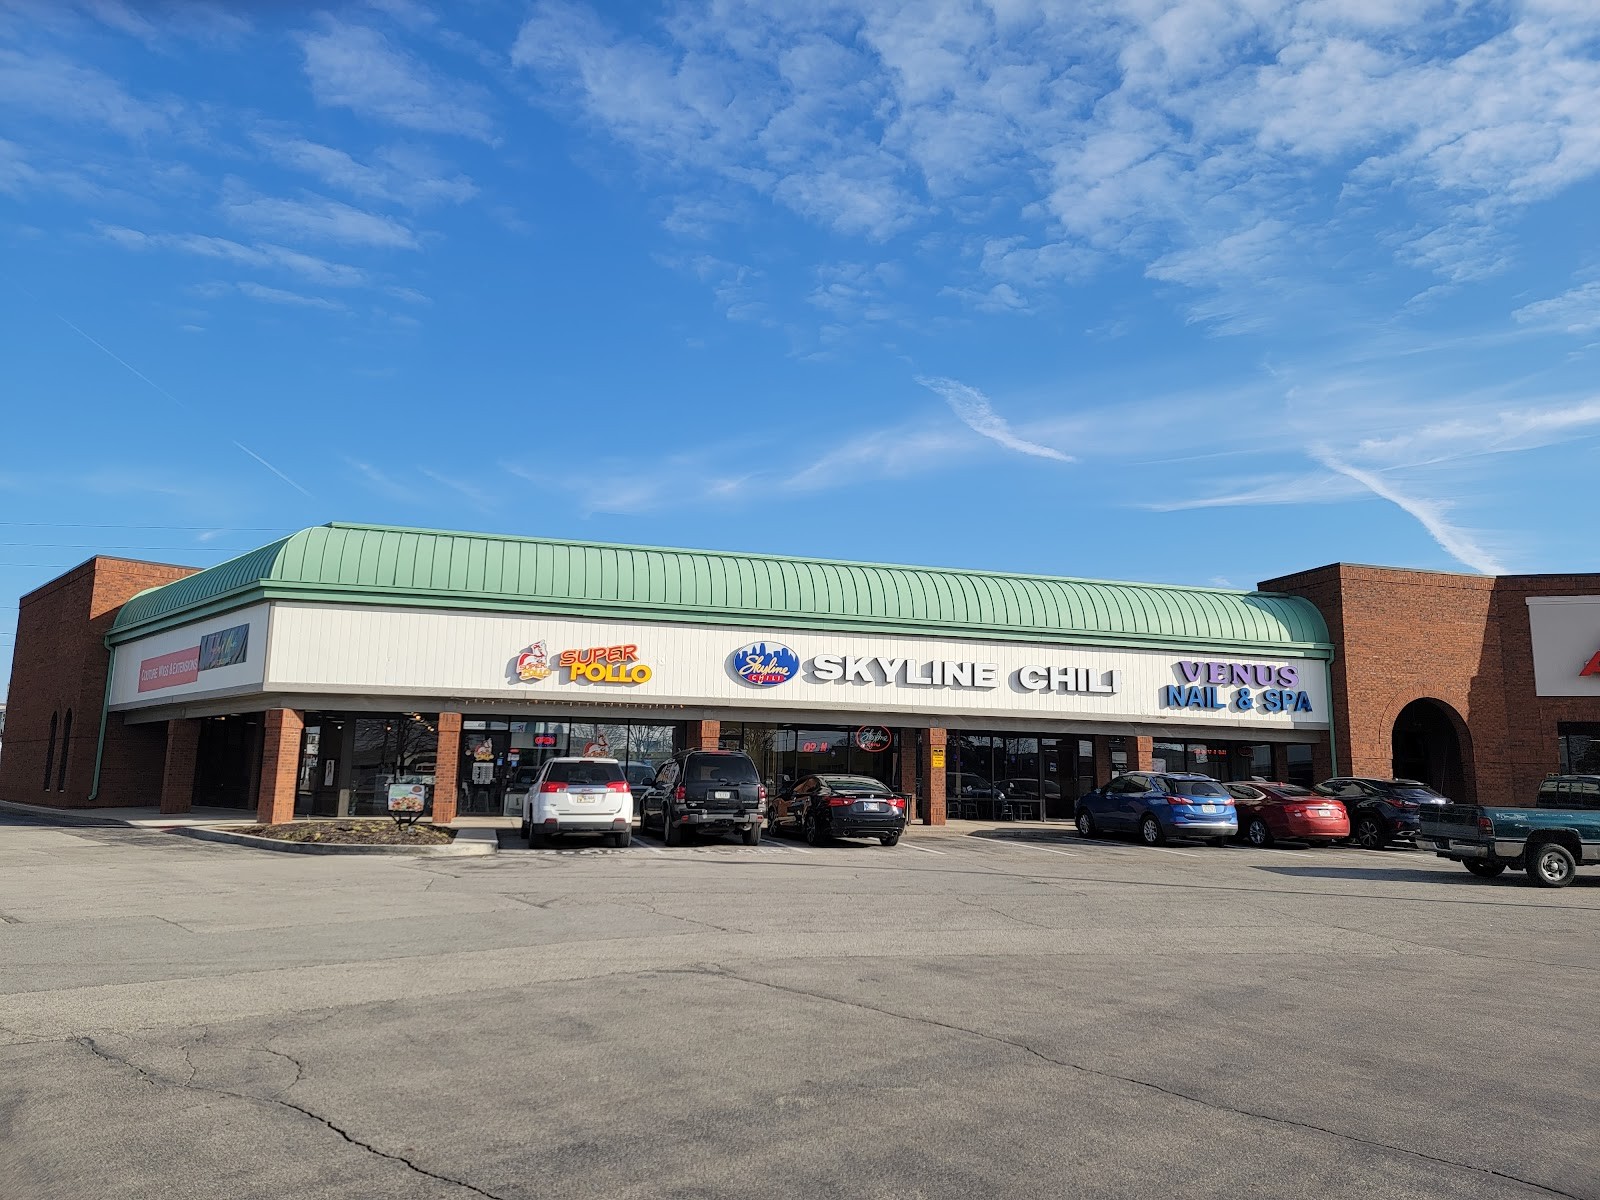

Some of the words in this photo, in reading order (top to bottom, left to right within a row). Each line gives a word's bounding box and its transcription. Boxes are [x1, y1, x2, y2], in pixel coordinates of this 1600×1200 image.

[560, 644, 639, 666] SUPER
[570, 663, 652, 683] POLLO
[739, 655, 790, 683] Skyline
[813, 654, 999, 688] SKYLINE
[1019, 665, 1121, 693] CHILI
[1179, 660, 1299, 688] VENUS
[1167, 685, 1227, 708] NAIL
[1236, 688, 1254, 710] &
[1263, 689, 1313, 712] SPA
[803, 742, 828, 752] OPN
